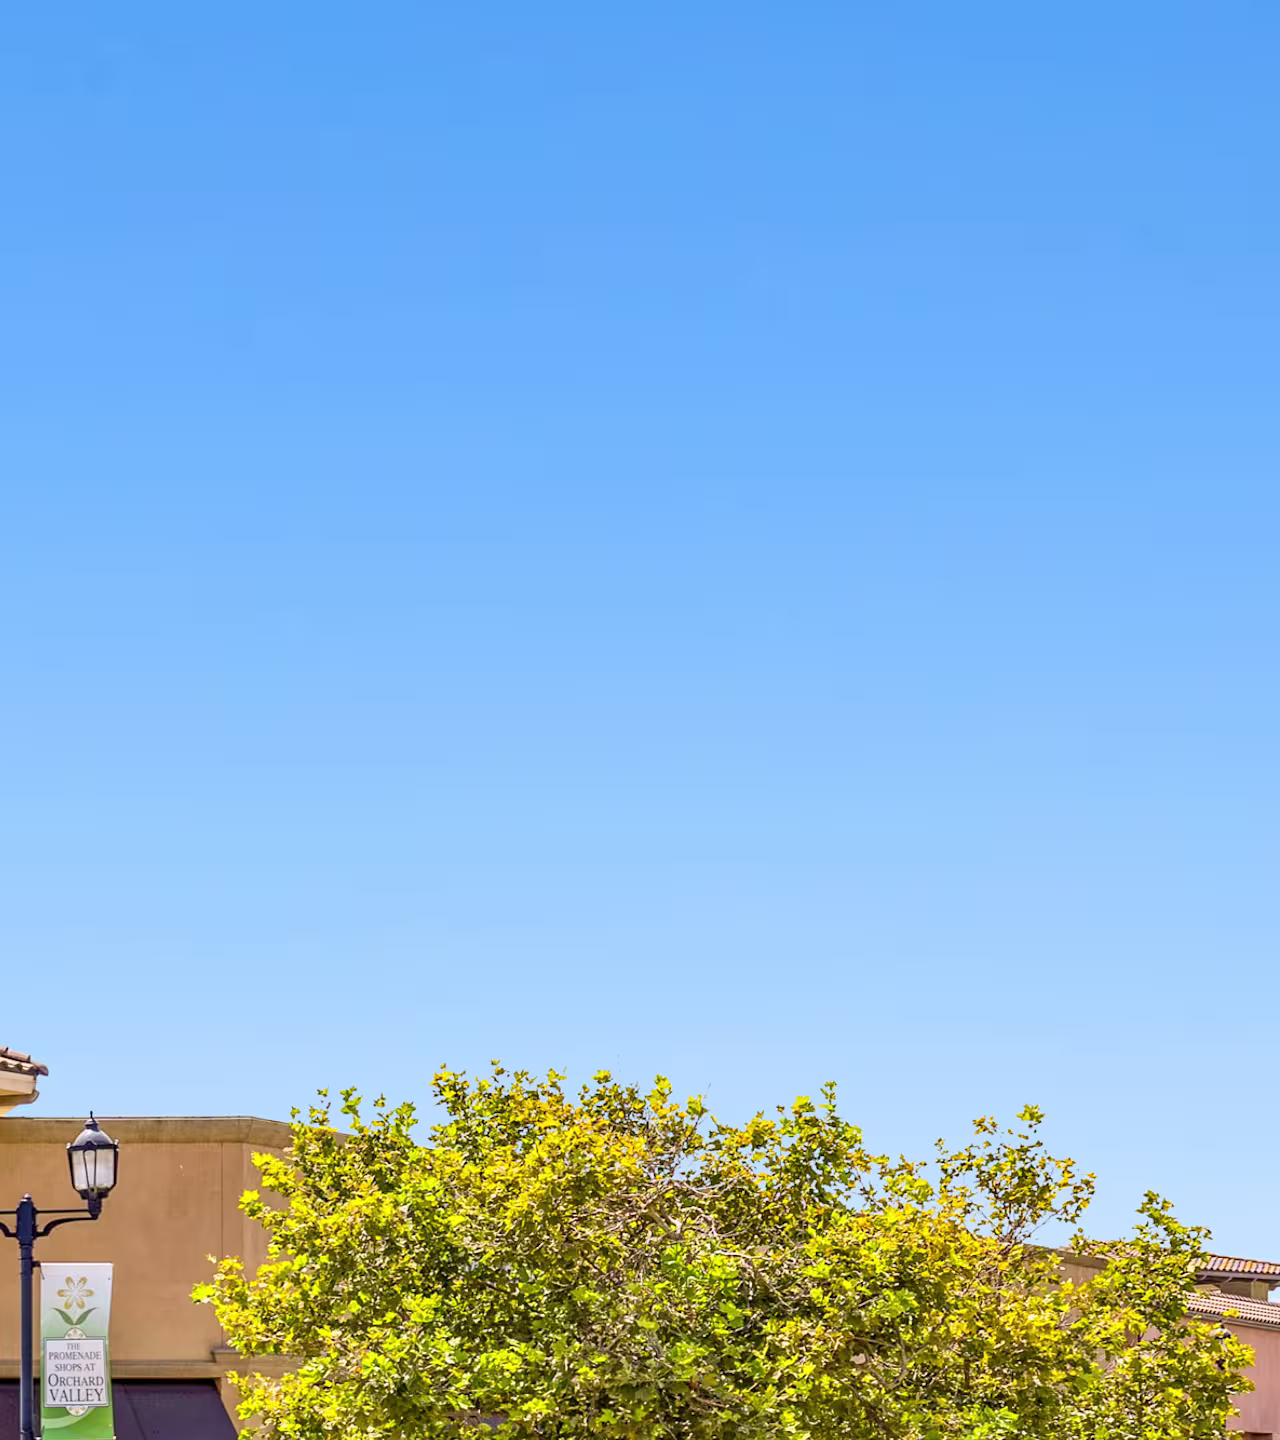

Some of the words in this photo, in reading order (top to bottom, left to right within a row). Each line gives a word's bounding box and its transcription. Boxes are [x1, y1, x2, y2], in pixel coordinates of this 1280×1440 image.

[48, 1351, 102, 1360] PROMENADE
[54, 1363, 82, 1372] SHOPS
[83, 1363, 96, 1372] AT
[48, 1373, 104, 1387] ORCHARD
[49, 1388, 104, 1402] VALLEY
